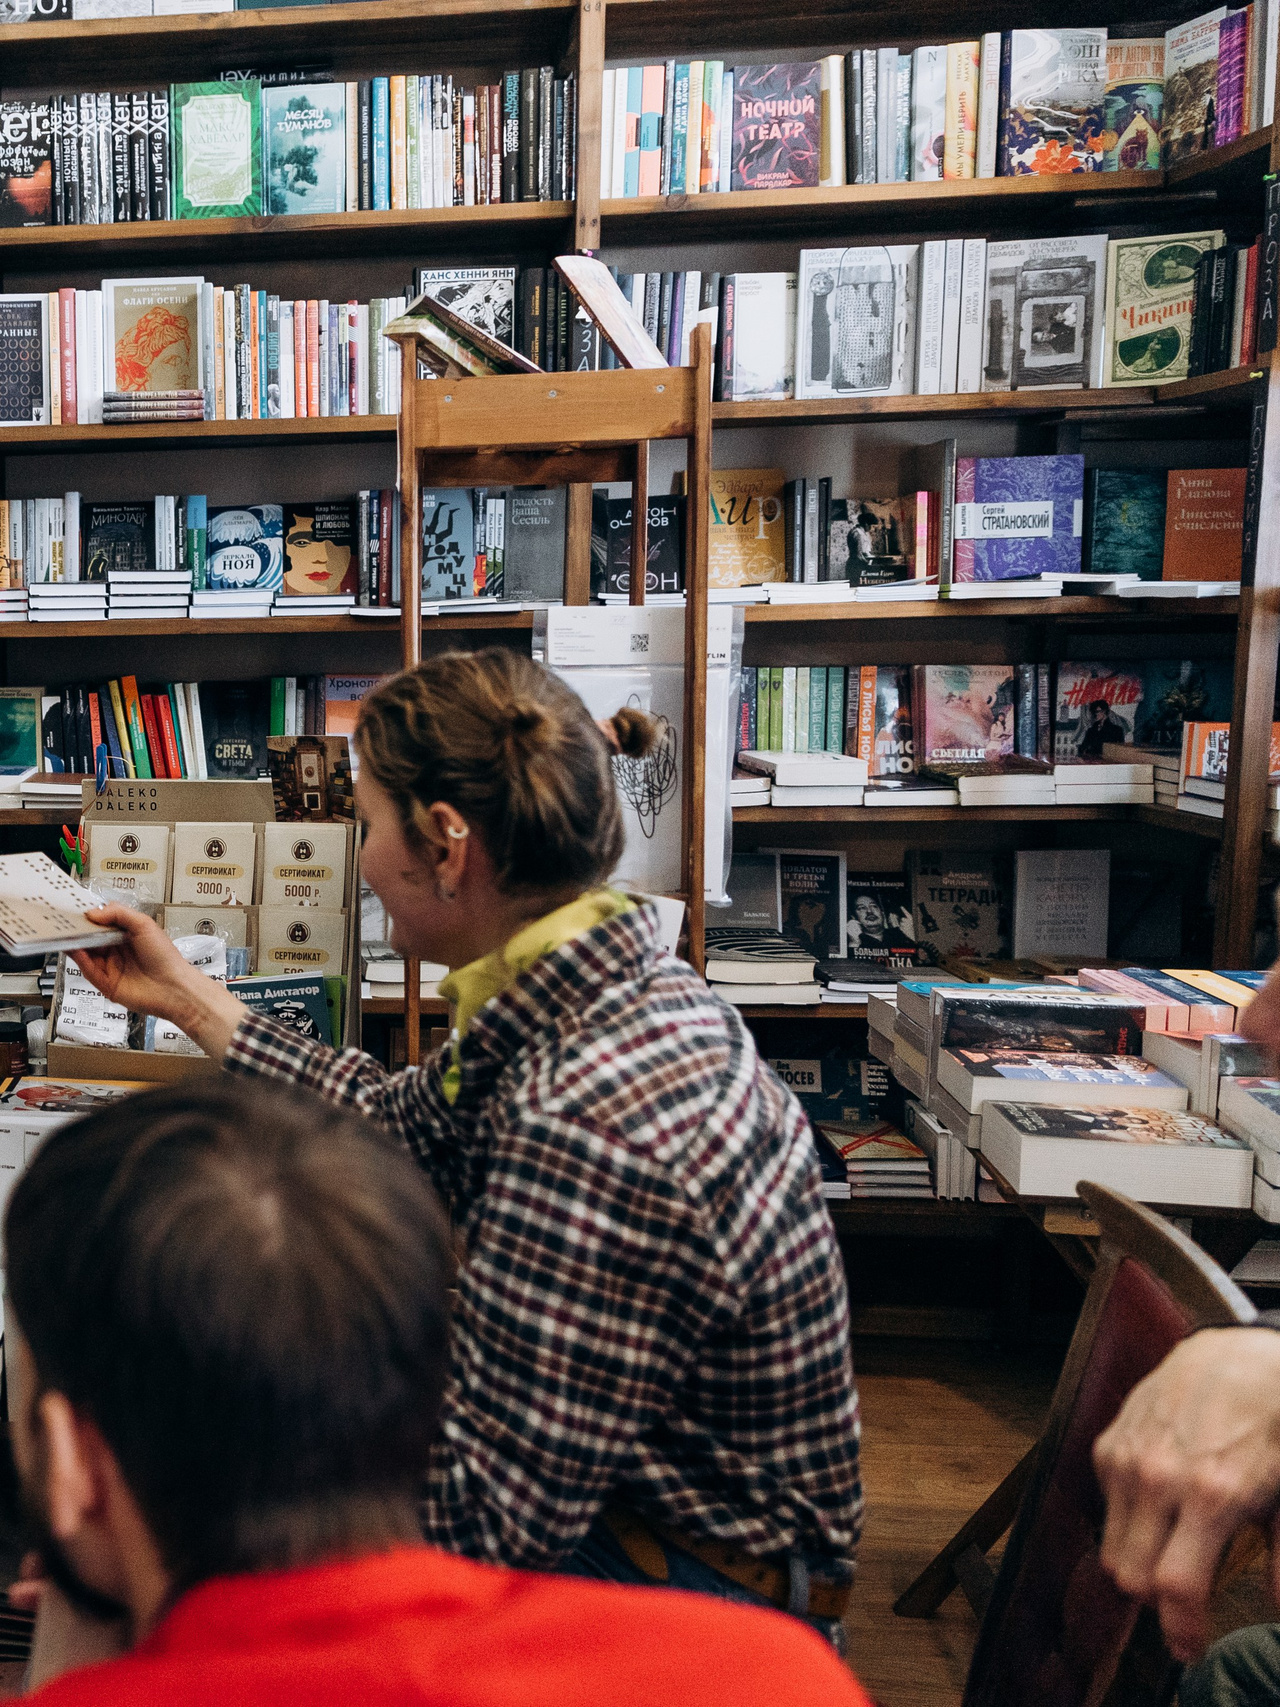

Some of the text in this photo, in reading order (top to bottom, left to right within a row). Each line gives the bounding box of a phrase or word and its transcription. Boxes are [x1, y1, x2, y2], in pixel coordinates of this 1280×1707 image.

[504, 75, 513, 112] Мортен
[741, 95, 814, 118] НОЧНОЙ
[284, 108, 324, 121] МЕСЯЦ
[200, 122, 234, 133] МАКС
[277, 118, 332, 131] ТУМАНОВ
[747, 123, 805, 141] ТЕАТР
[956, 90, 967, 177] МЫ УМЕЛИ ВЕРИТЬ
[63, 138, 71, 182] ночные
[70, 137, 79, 182] рассказы
[153, 132, 163, 193] тишина
[756, 172, 789, 181] ВИКРАМ
[807, 250, 837, 258] ГЕОРГИЙ
[989, 250, 1025, 258] ДЕМИДОВ
[807, 257, 841, 265] ДЕМИДОВ
[422, 268, 514, 280] ХАНС ХЕННИ ЯНН
[123, 295, 189, 306] ФЛАГИ ОСЕНИ
[726, 283, 734, 330] НОЧНОЙ ТЕАТР
[971, 291, 979, 325] ДЕМИДОВ
[268, 331, 279, 369] ОФЕЛИЯ
[1179, 477, 1213, 487] Анна
[1176, 487, 1231, 499] Глазова
[512, 497, 554, 508] радость
[512, 506, 540, 516] наша
[982, 505, 1005, 516] Сергей
[91, 513, 147, 530] МИНОТАВР
[315, 513, 350, 522] ШПИОНАЖ
[511, 515, 550, 526] Сесиль
[982, 511, 1050, 530] СТРАТАНОВСКИЙ
[323, 521, 350, 529] ЛЮБОВЬ
[222, 553, 255, 561] ЗЕРКАЛО
[222, 559, 255, 571] НОЯ
[861, 691, 872, 731] ЛИСЬЯ
[215, 743, 253, 759] СВЕТА
[229, 759, 246, 767] ТЬМЫ
[96, 801, 158, 811] DALEKO
[106, 861, 150, 871] СЕРТИФИКАТ
[191, 865, 236, 876] СЕРТИФИКАТ
[279, 868, 325, 879] СЕРТИФИКАТ
[196, 882, 222, 895] 3000
[789, 880, 819, 889] ВОЛНА
[284, 884, 311, 897] 5000
[928, 887, 1004, 905] ТЕТРАДИ
[275, 951, 321, 962] СЕРТИФИКАТ
[854, 947, 889, 957] БОЛЬШАЯ
[264, 984, 320, 999] Диктатор
[776, 1061, 790, 1070] Лев
